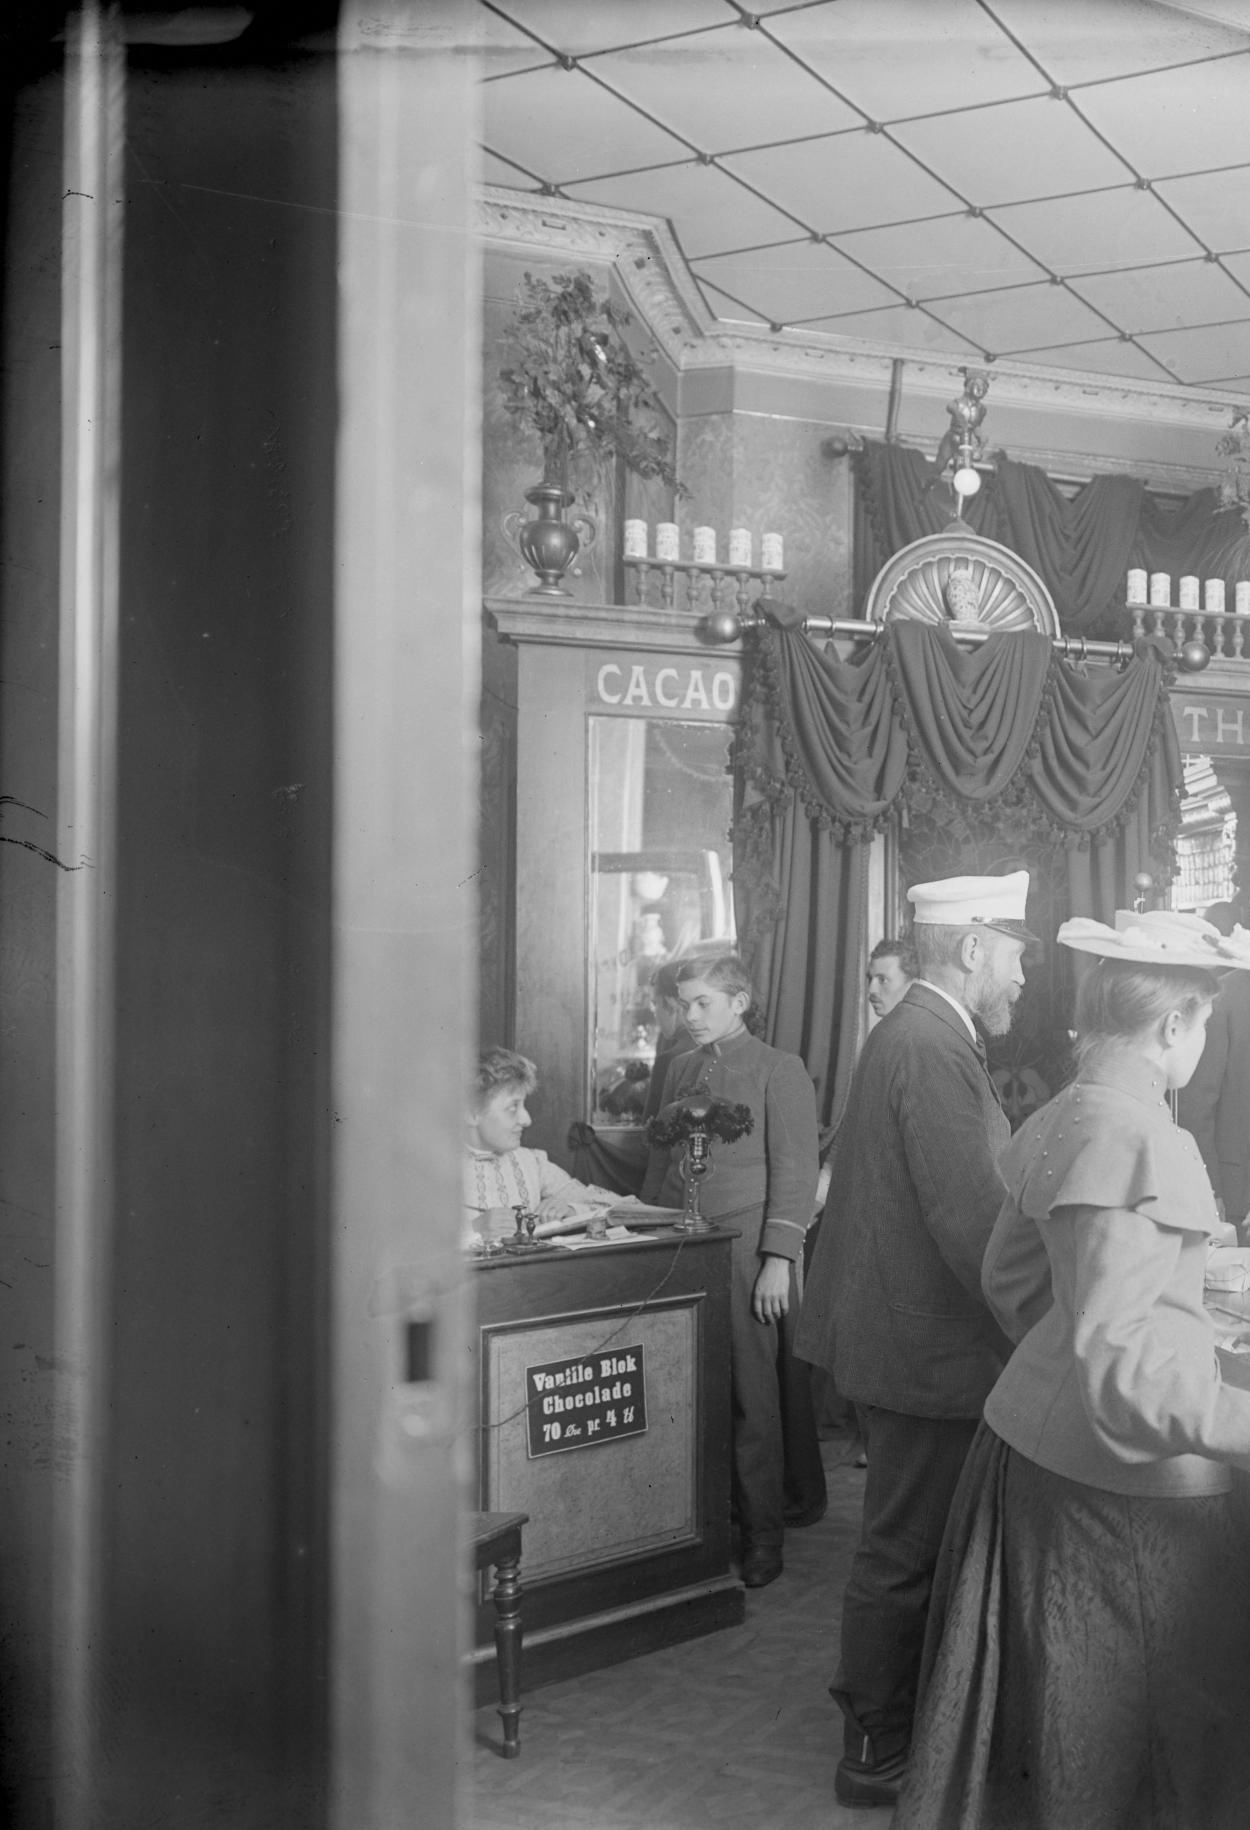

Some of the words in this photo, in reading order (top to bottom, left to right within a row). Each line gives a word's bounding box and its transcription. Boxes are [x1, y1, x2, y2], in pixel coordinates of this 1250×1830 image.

[597, 663, 736, 710] CACAO
[600, 1354, 637, 1378] Blok
[543, 1381, 632, 1415] Chocolade
[543, 1421, 562, 1442] 70
